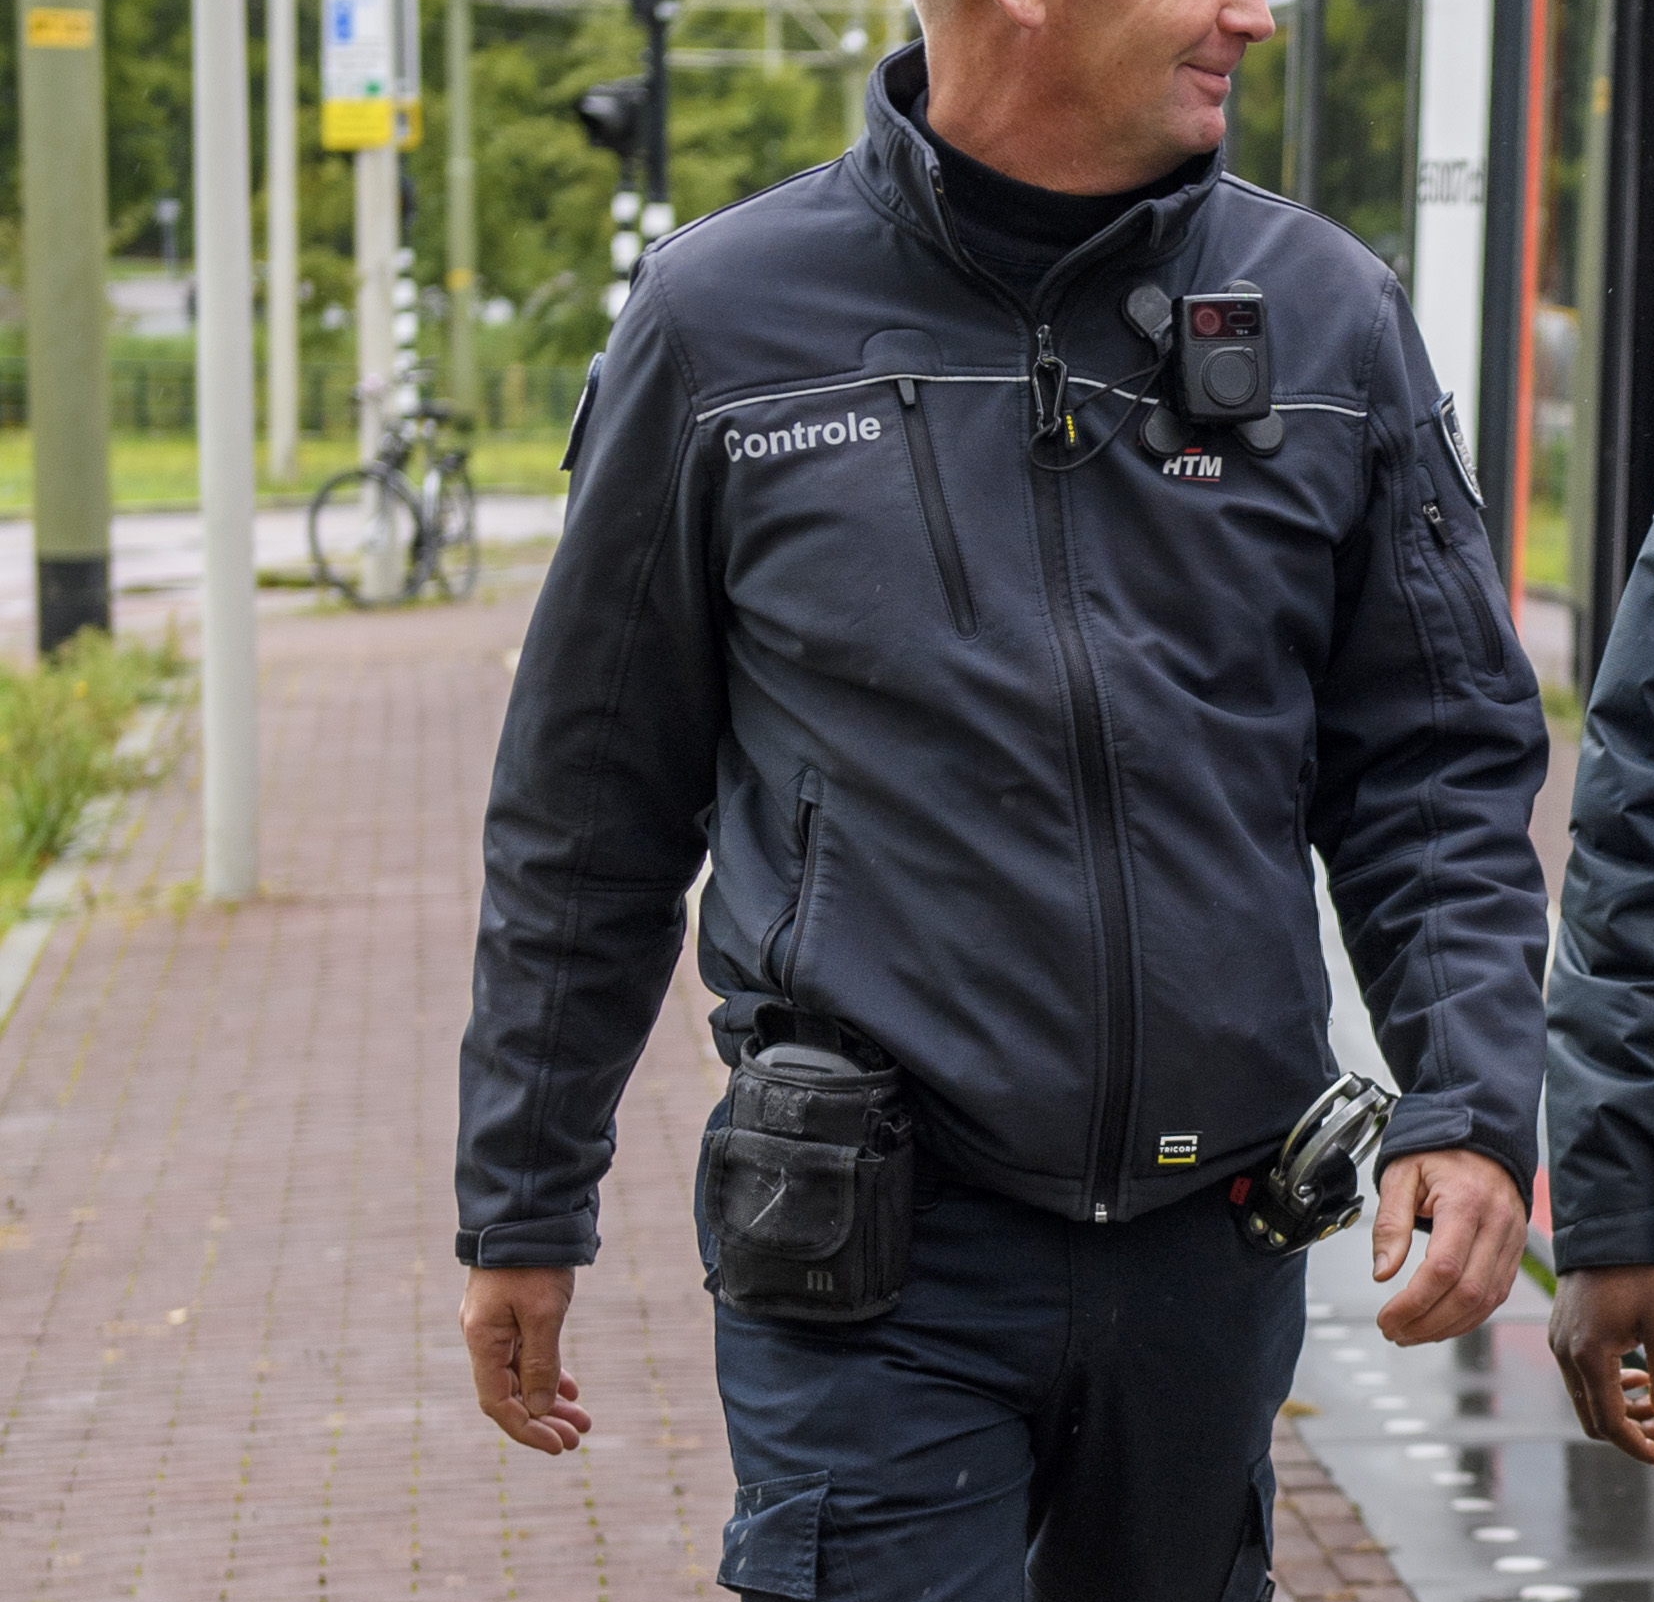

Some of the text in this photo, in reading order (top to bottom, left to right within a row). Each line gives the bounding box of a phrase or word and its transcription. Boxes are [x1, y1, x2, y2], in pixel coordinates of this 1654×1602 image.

[724, 412, 882, 463] Controle
[1162, 455, 1222, 477] HTM
[1159, 1145, 1198, 1154] TRICORP
